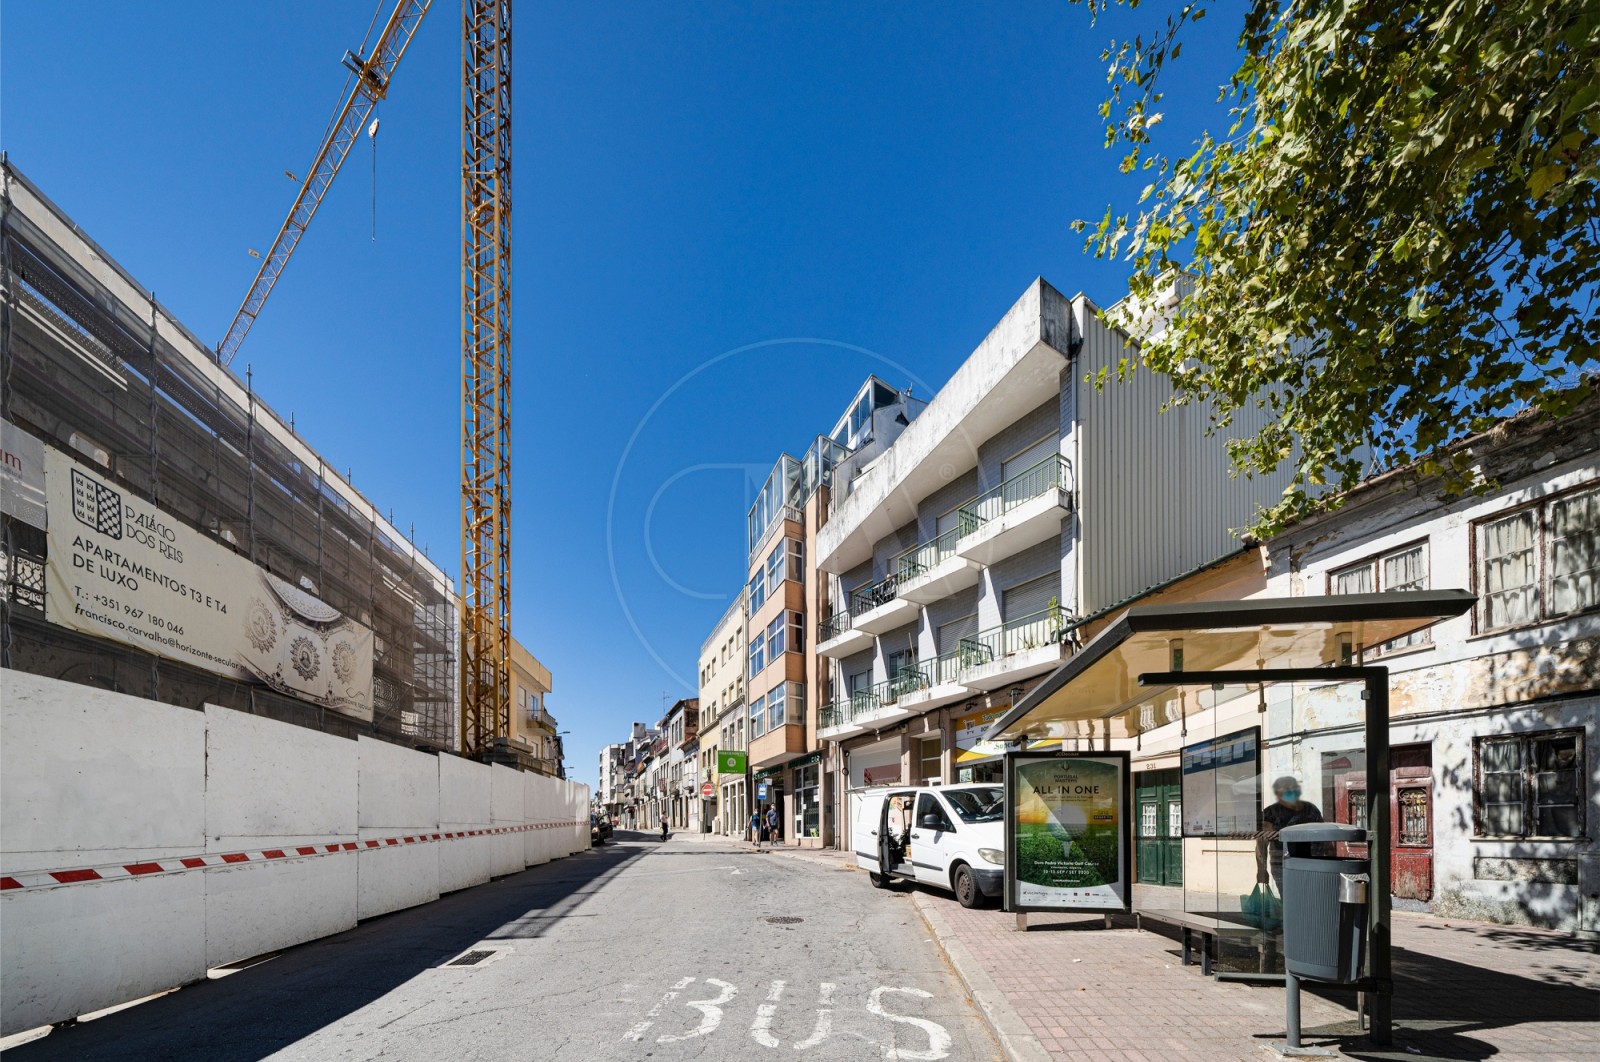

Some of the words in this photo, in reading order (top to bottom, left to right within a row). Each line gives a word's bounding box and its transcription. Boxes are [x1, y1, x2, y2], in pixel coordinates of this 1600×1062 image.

[125, 504, 176, 543] PALÁCIO
[126, 523, 156, 549] DOS
[159, 540, 184, 564] REIS
[72, 535, 188, 595] APARTAMENTOS
[190, 588, 203, 604] T3
[206, 596, 213, 608] E
[215, 599, 228, 615] T4
[73, 553, 95, 574] DE
[100, 564, 139, 592] LUXO
[75, 585, 89, 600] T.:
[94, 594, 120, 612] +351
[124, 605, 145, 619] 967
[148, 613, 165, 628] 180
[167, 622, 185, 636] 046
[1033, 785, 1053, 795] ALL
[1057, 785, 1070, 795] IN
[1074, 785, 1100, 795] ONE
[620, 976, 953, 1061] BUS
